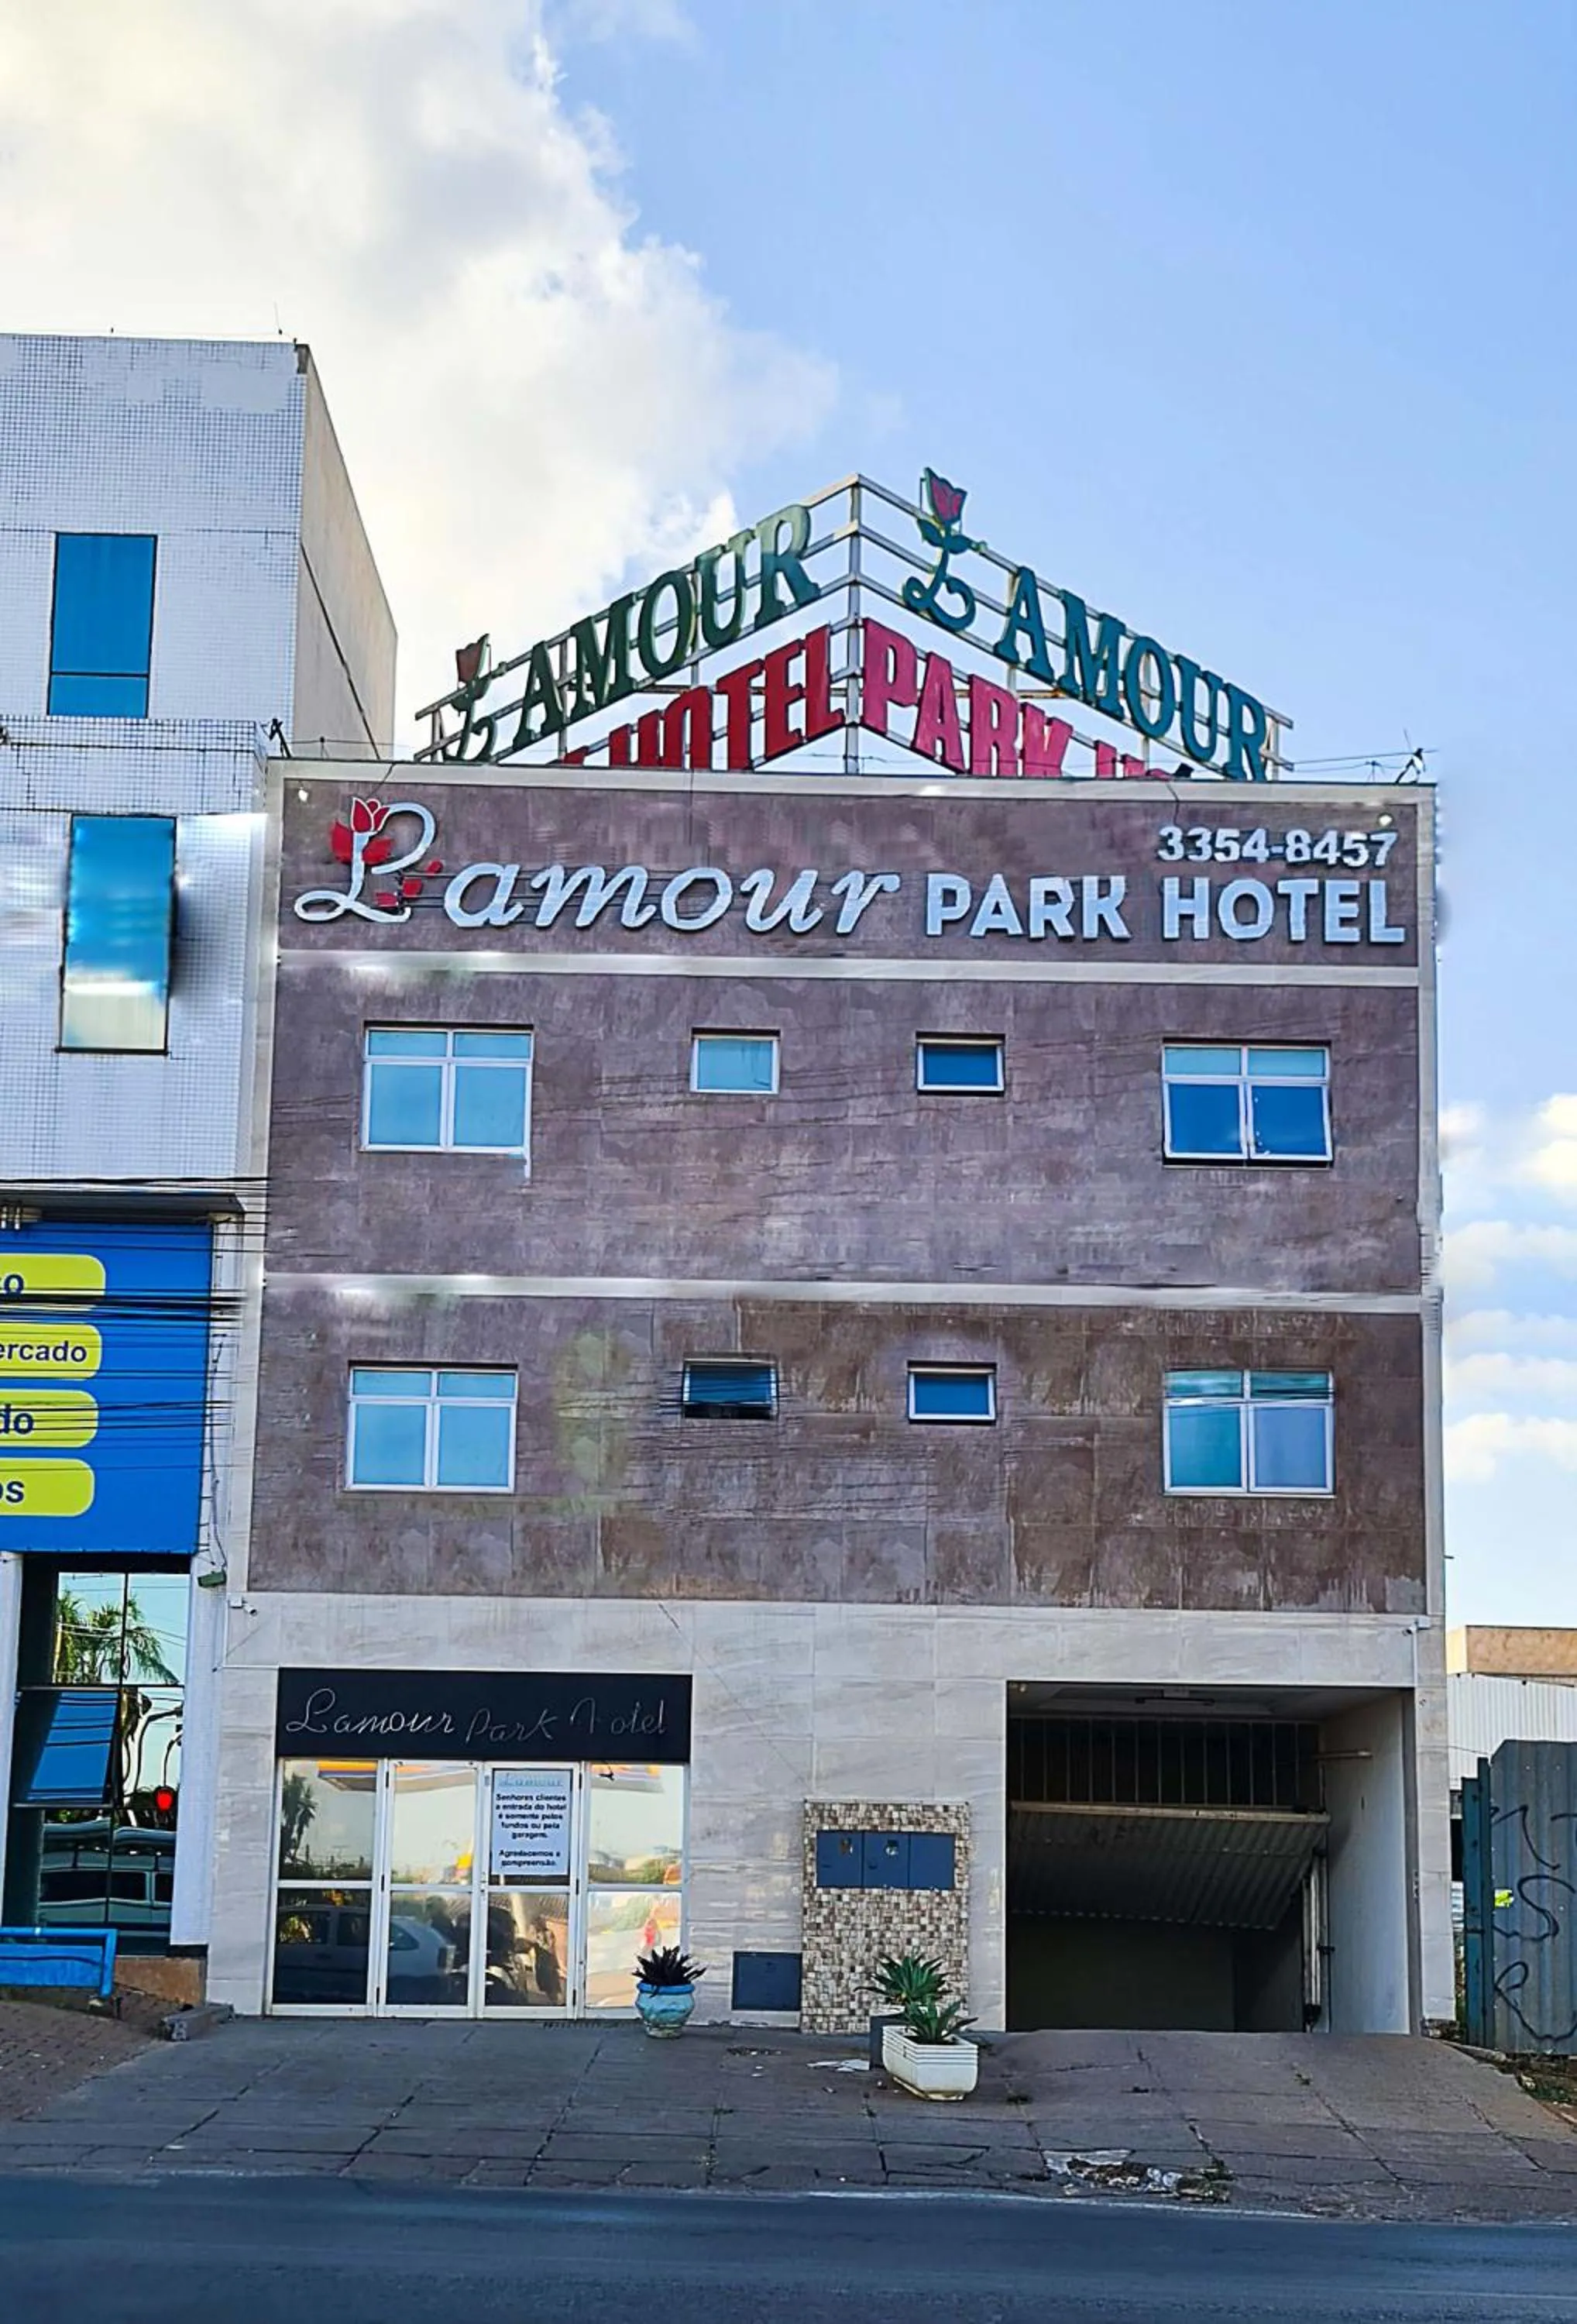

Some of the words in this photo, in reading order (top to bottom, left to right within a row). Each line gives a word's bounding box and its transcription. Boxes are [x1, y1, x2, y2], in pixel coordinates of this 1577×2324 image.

[861, 617, 1074, 779] PARK
[294, 796, 900, 934] Lamour
[926, 873, 1132, 940] PARK
[1162, 875, 1406, 944] HOTEL
[1157, 824, 1400, 867] 3354-8457
[285, 1687, 455, 1734] Lamour
[465, 1707, 558, 1744] Park
[496, 1793, 534, 1802] Senhores
[536, 1793, 567, 1802] clientes
